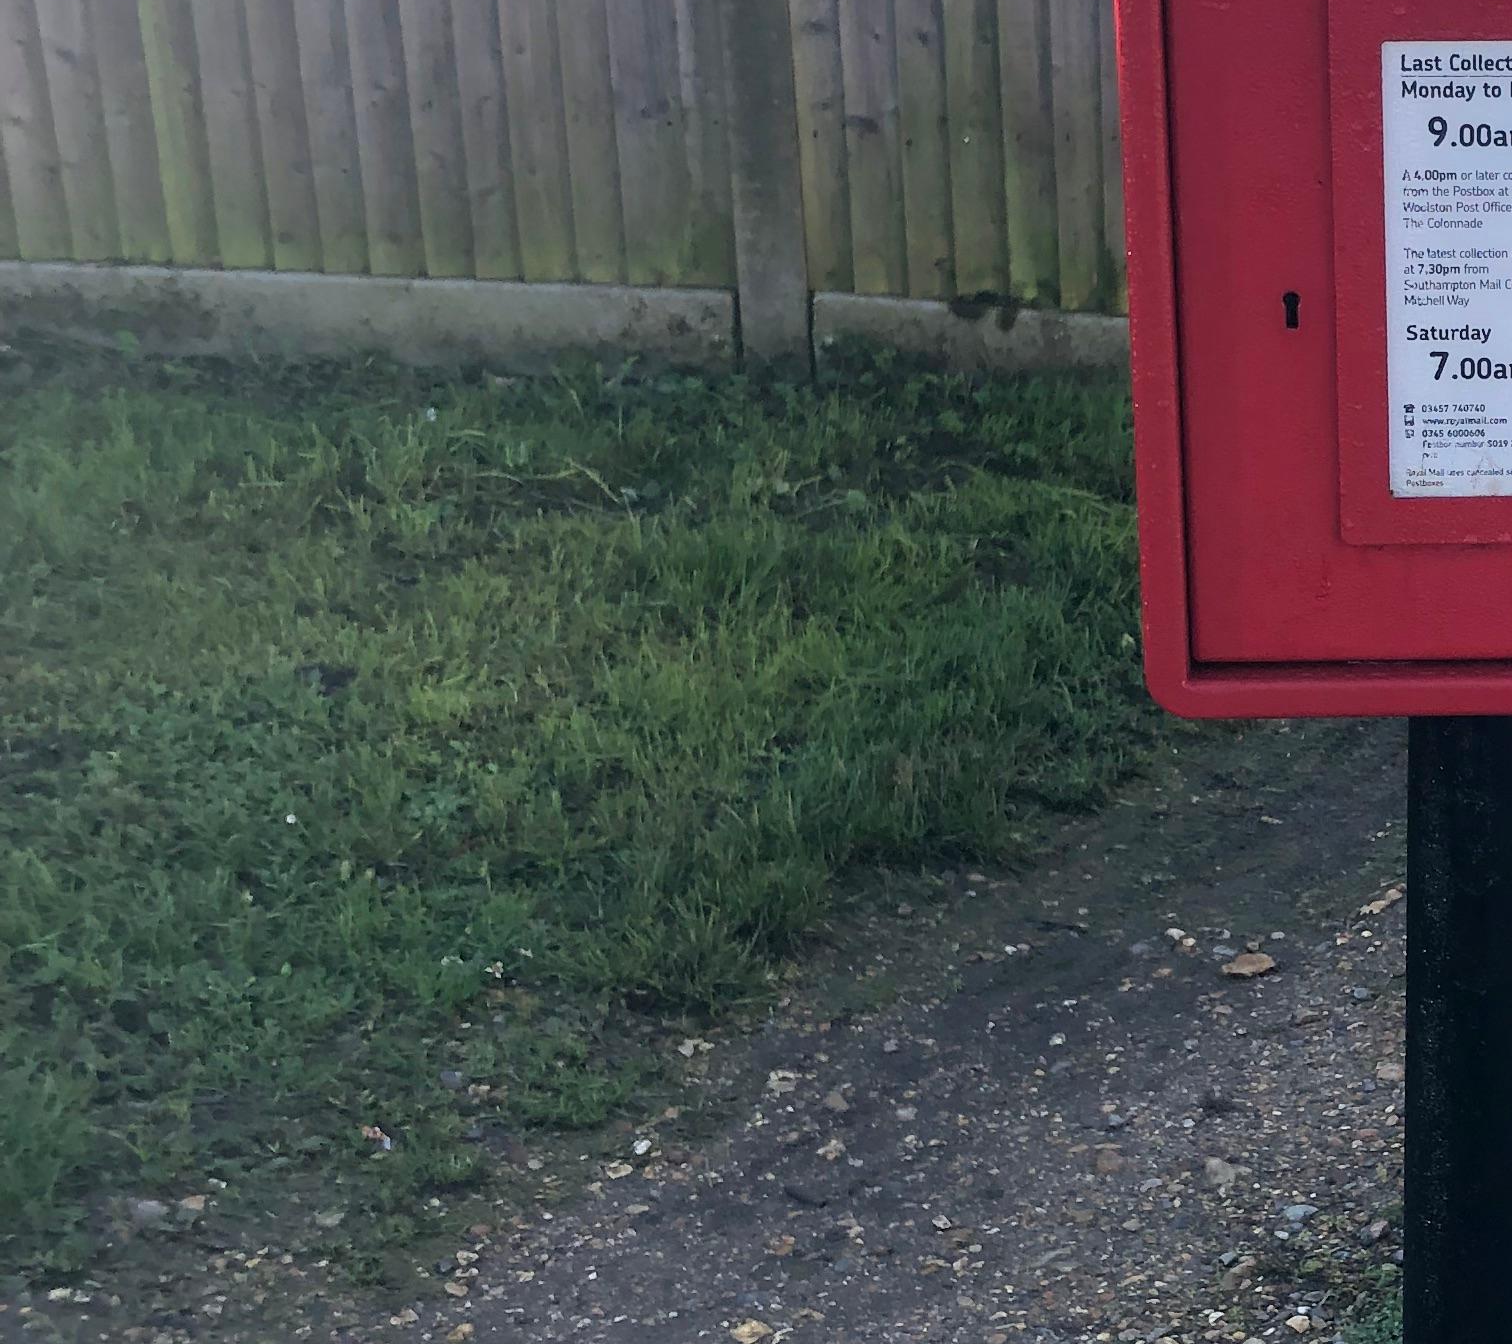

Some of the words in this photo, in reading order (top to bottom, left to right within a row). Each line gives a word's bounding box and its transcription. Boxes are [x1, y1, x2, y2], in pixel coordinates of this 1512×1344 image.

[1401, 54, 1441, 72] Last
[1401, 81, 1475, 101] Monday
[1483, 83, 1501, 98] to
[1402, 170, 1411, 181] A
[1461, 171, 1473, 180] or
[1475, 170, 1499, 180] later
[1403, 186, 1428, 197] from
[1432, 186, 1449, 197] the
[1453, 186, 1494, 197] Postbox
[1498, 187, 1508, 197] at
[1403, 202, 1452, 213] Woolston
[1456, 202, 1479, 213] Post
[1403, 218, 1422, 229] The
[1427, 218, 1483, 229] Colonnade
[1404, 248, 1424, 259] The
[1427, 248, 1456, 259] latest
[1459, 248, 1508, 259] collection
[1404, 265, 1415, 274] at
[1464, 264, 1489, 274] from
[1404, 280, 1475, 292] Southampton
[1480, 280, 1501, 290] Mail
[1447, 295, 1469, 308] Way
[1407, 325, 1491, 344] Saturday
[1422, 405, 1448, 413] 03457
[1452, 405, 1485, 413] 740740
[1422, 429, 1445, 438] 0345
